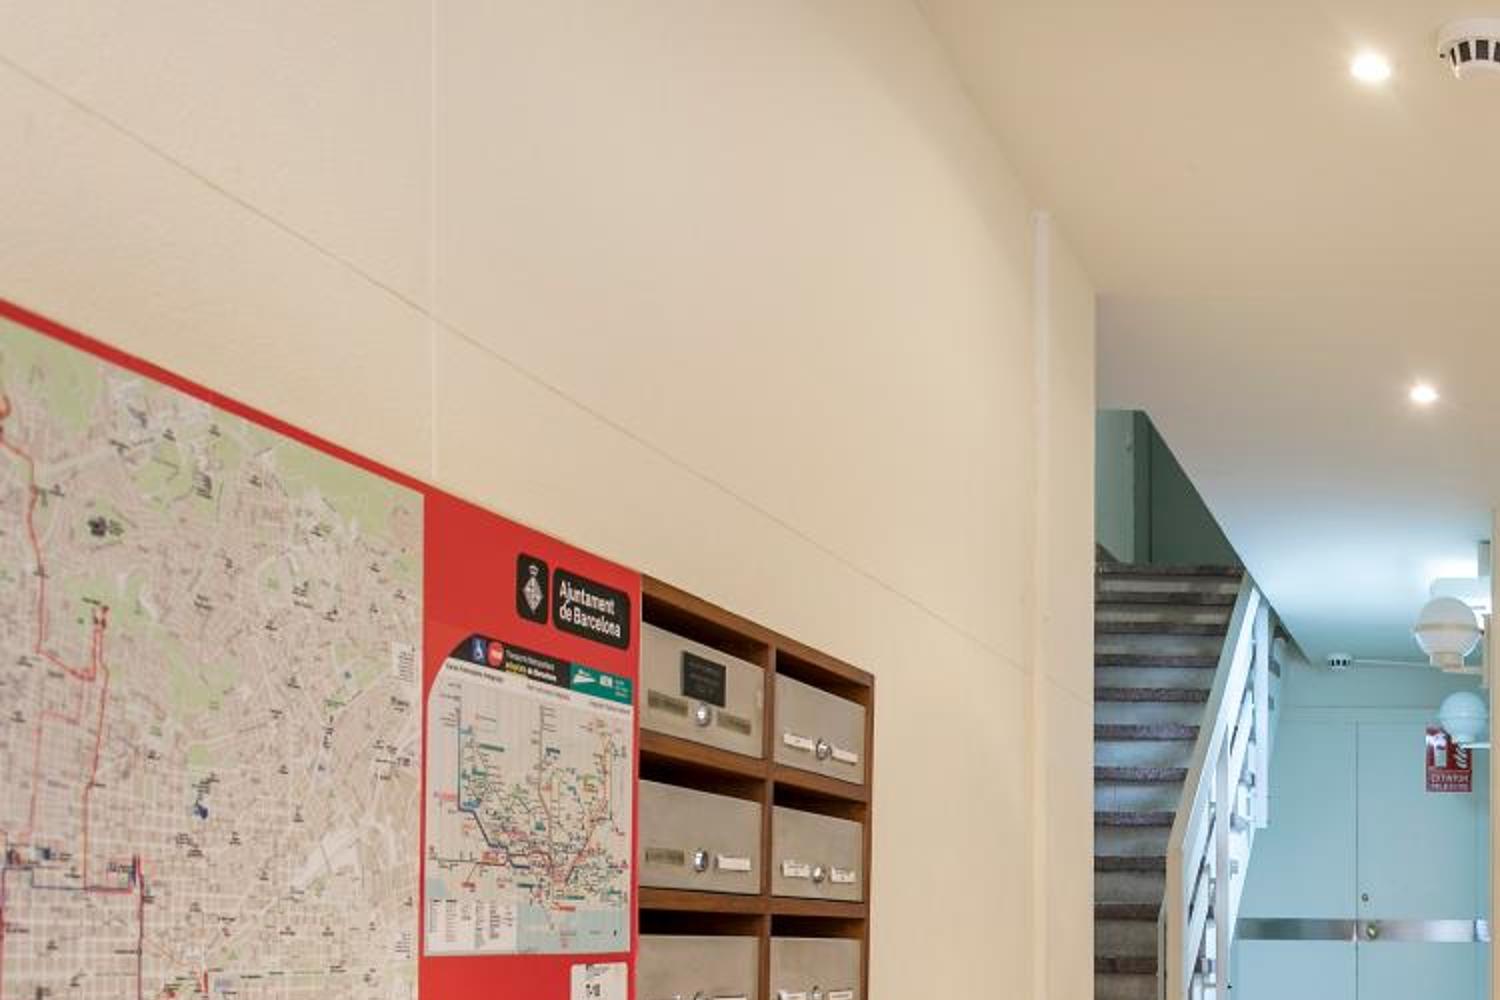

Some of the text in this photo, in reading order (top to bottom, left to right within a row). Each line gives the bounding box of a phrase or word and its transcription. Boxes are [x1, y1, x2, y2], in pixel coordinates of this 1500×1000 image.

[559, 580, 615, 615] Ajuntament
[559, 603, 621, 639] de Barcelona
